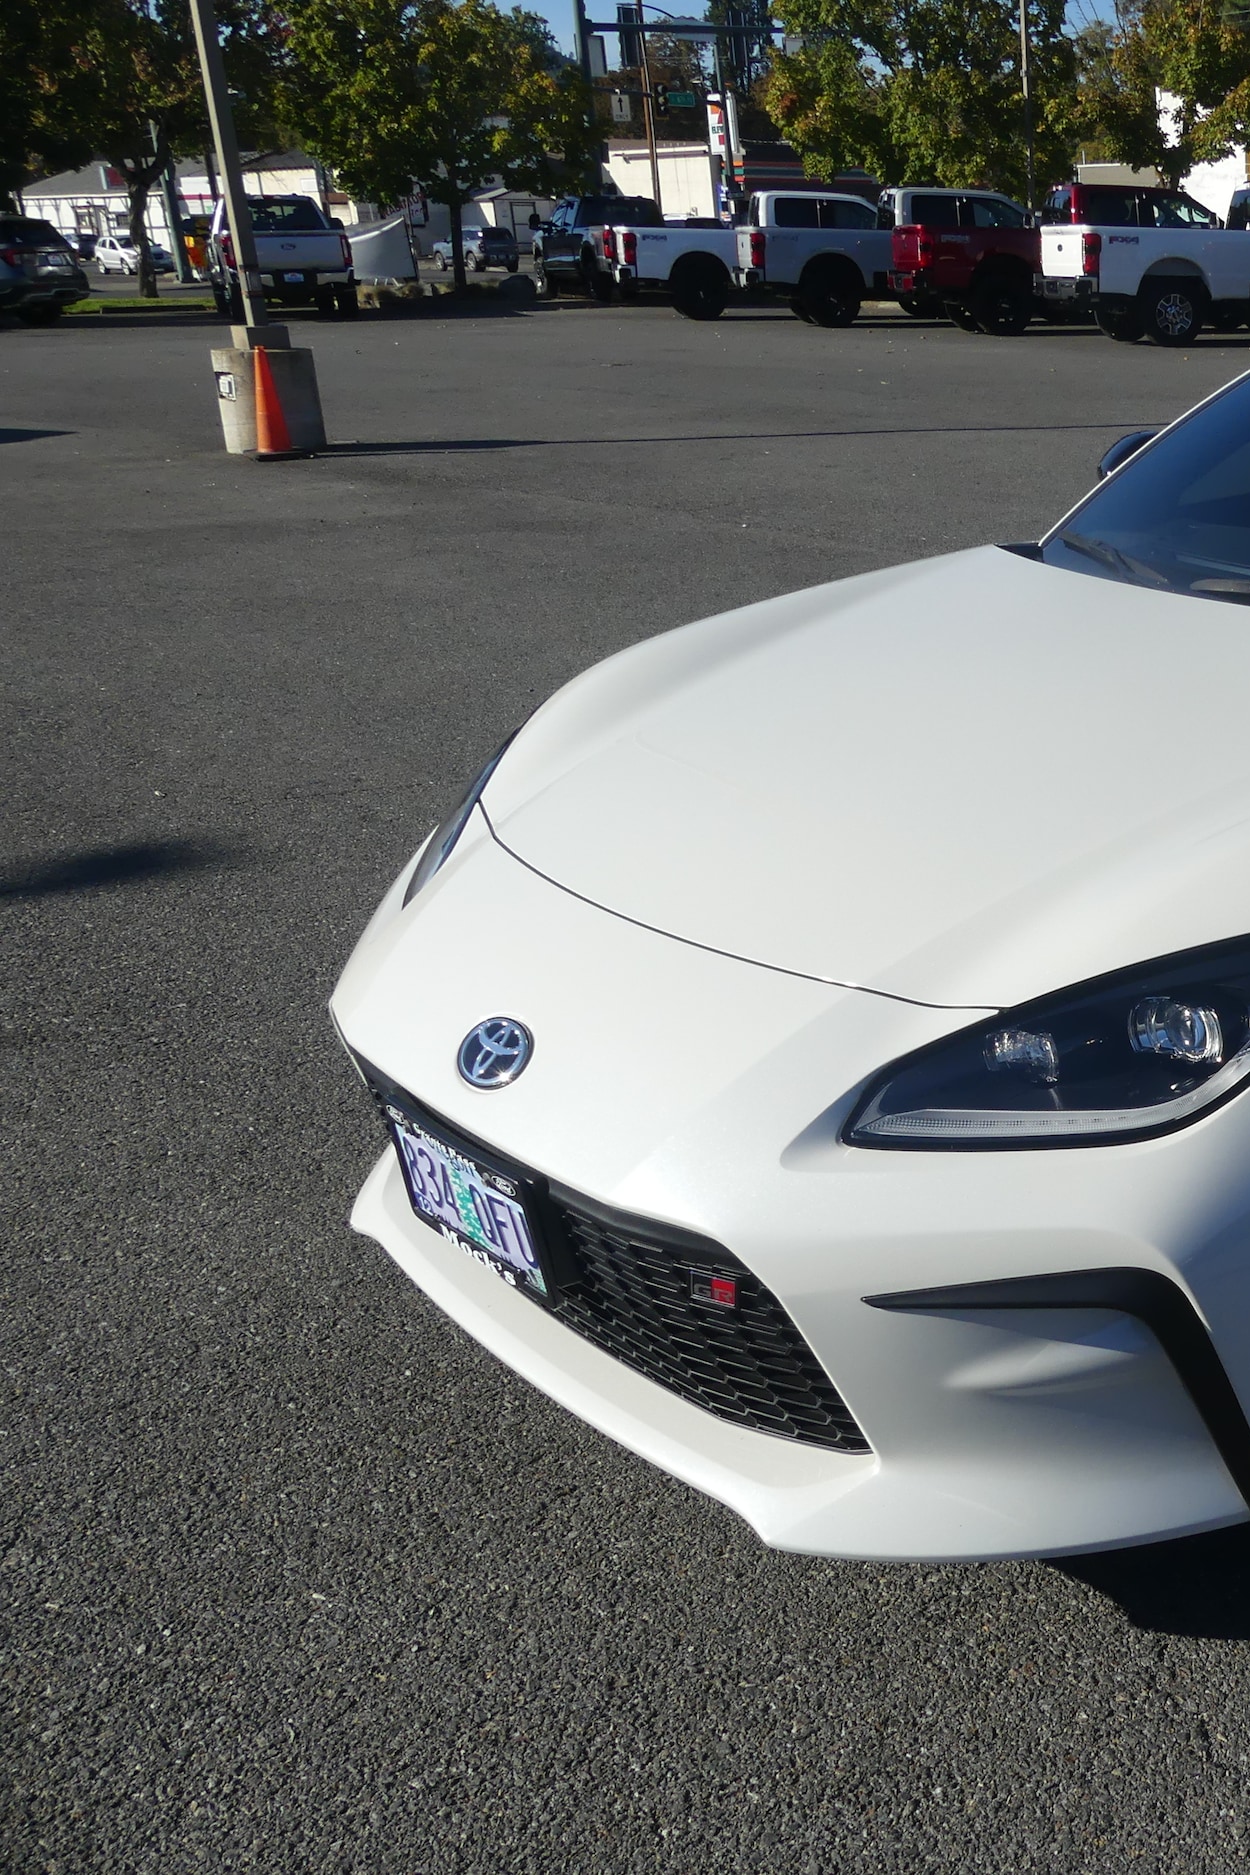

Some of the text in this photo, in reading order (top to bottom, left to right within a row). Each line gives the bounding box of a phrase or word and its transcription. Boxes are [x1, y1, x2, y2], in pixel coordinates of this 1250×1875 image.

[402, 1135, 540, 1269] 834 QFU
[440, 1223, 517, 1286] Mock's
[694, 1283, 733, 1301] GR
